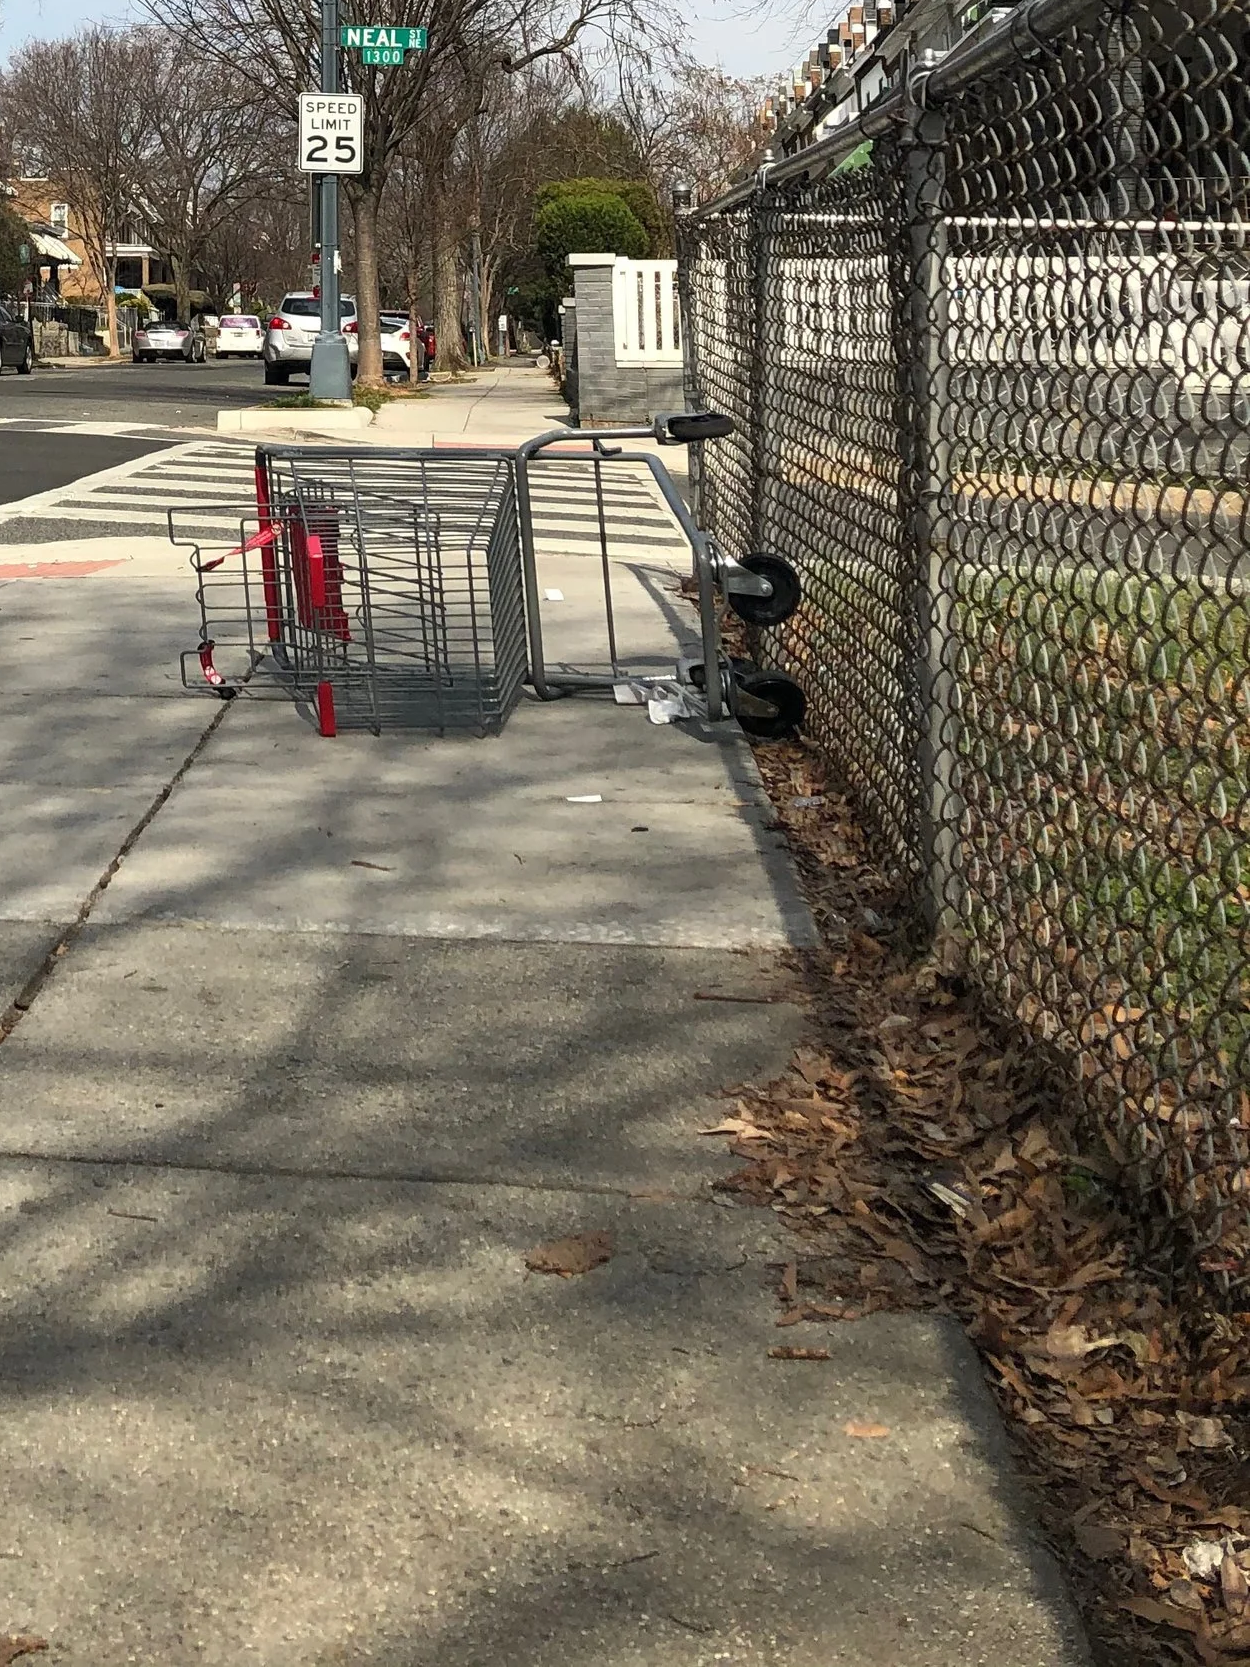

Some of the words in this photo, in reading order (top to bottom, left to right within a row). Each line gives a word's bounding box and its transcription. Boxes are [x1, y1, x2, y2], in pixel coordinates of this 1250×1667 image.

[347, 28, 403, 48] NEAL
[409, 29, 422, 39] ST
[408, 38, 422, 49] NE
[366, 50, 401, 64] 1300
[305, 101, 358, 115] SPEED
[311, 118, 352, 131] LIMIT
[305, 135, 357, 164] 25
